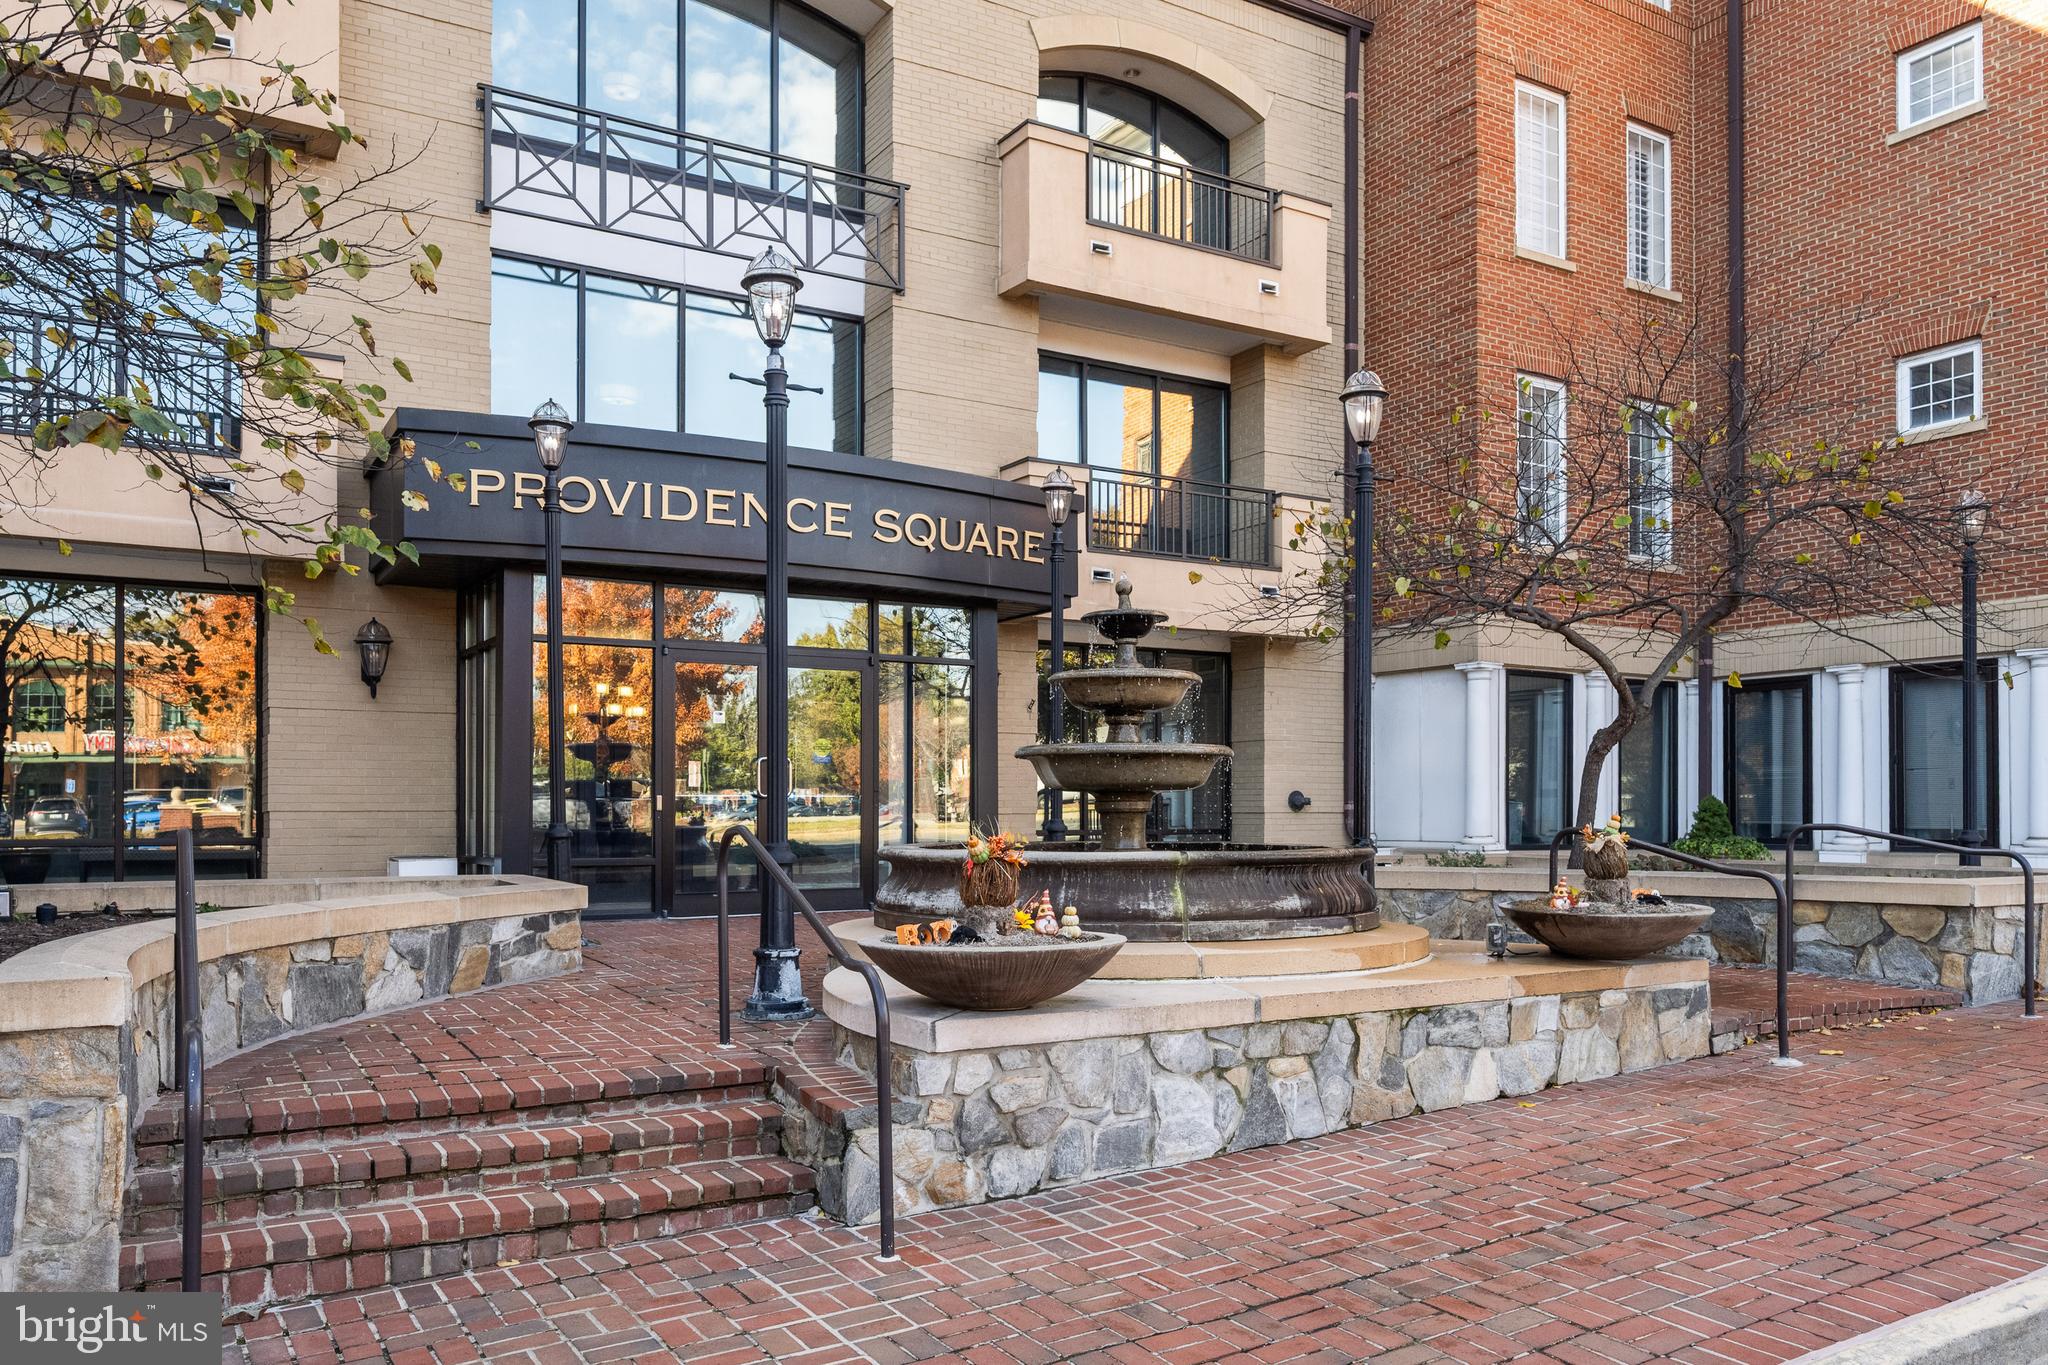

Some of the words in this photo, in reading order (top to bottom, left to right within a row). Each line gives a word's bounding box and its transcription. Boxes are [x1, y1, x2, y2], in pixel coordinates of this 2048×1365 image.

[469, 468, 853, 539] PROVIDENCE
[872, 508, 1045, 565] SQUARE
[896, 919, 952, 945] BOO
